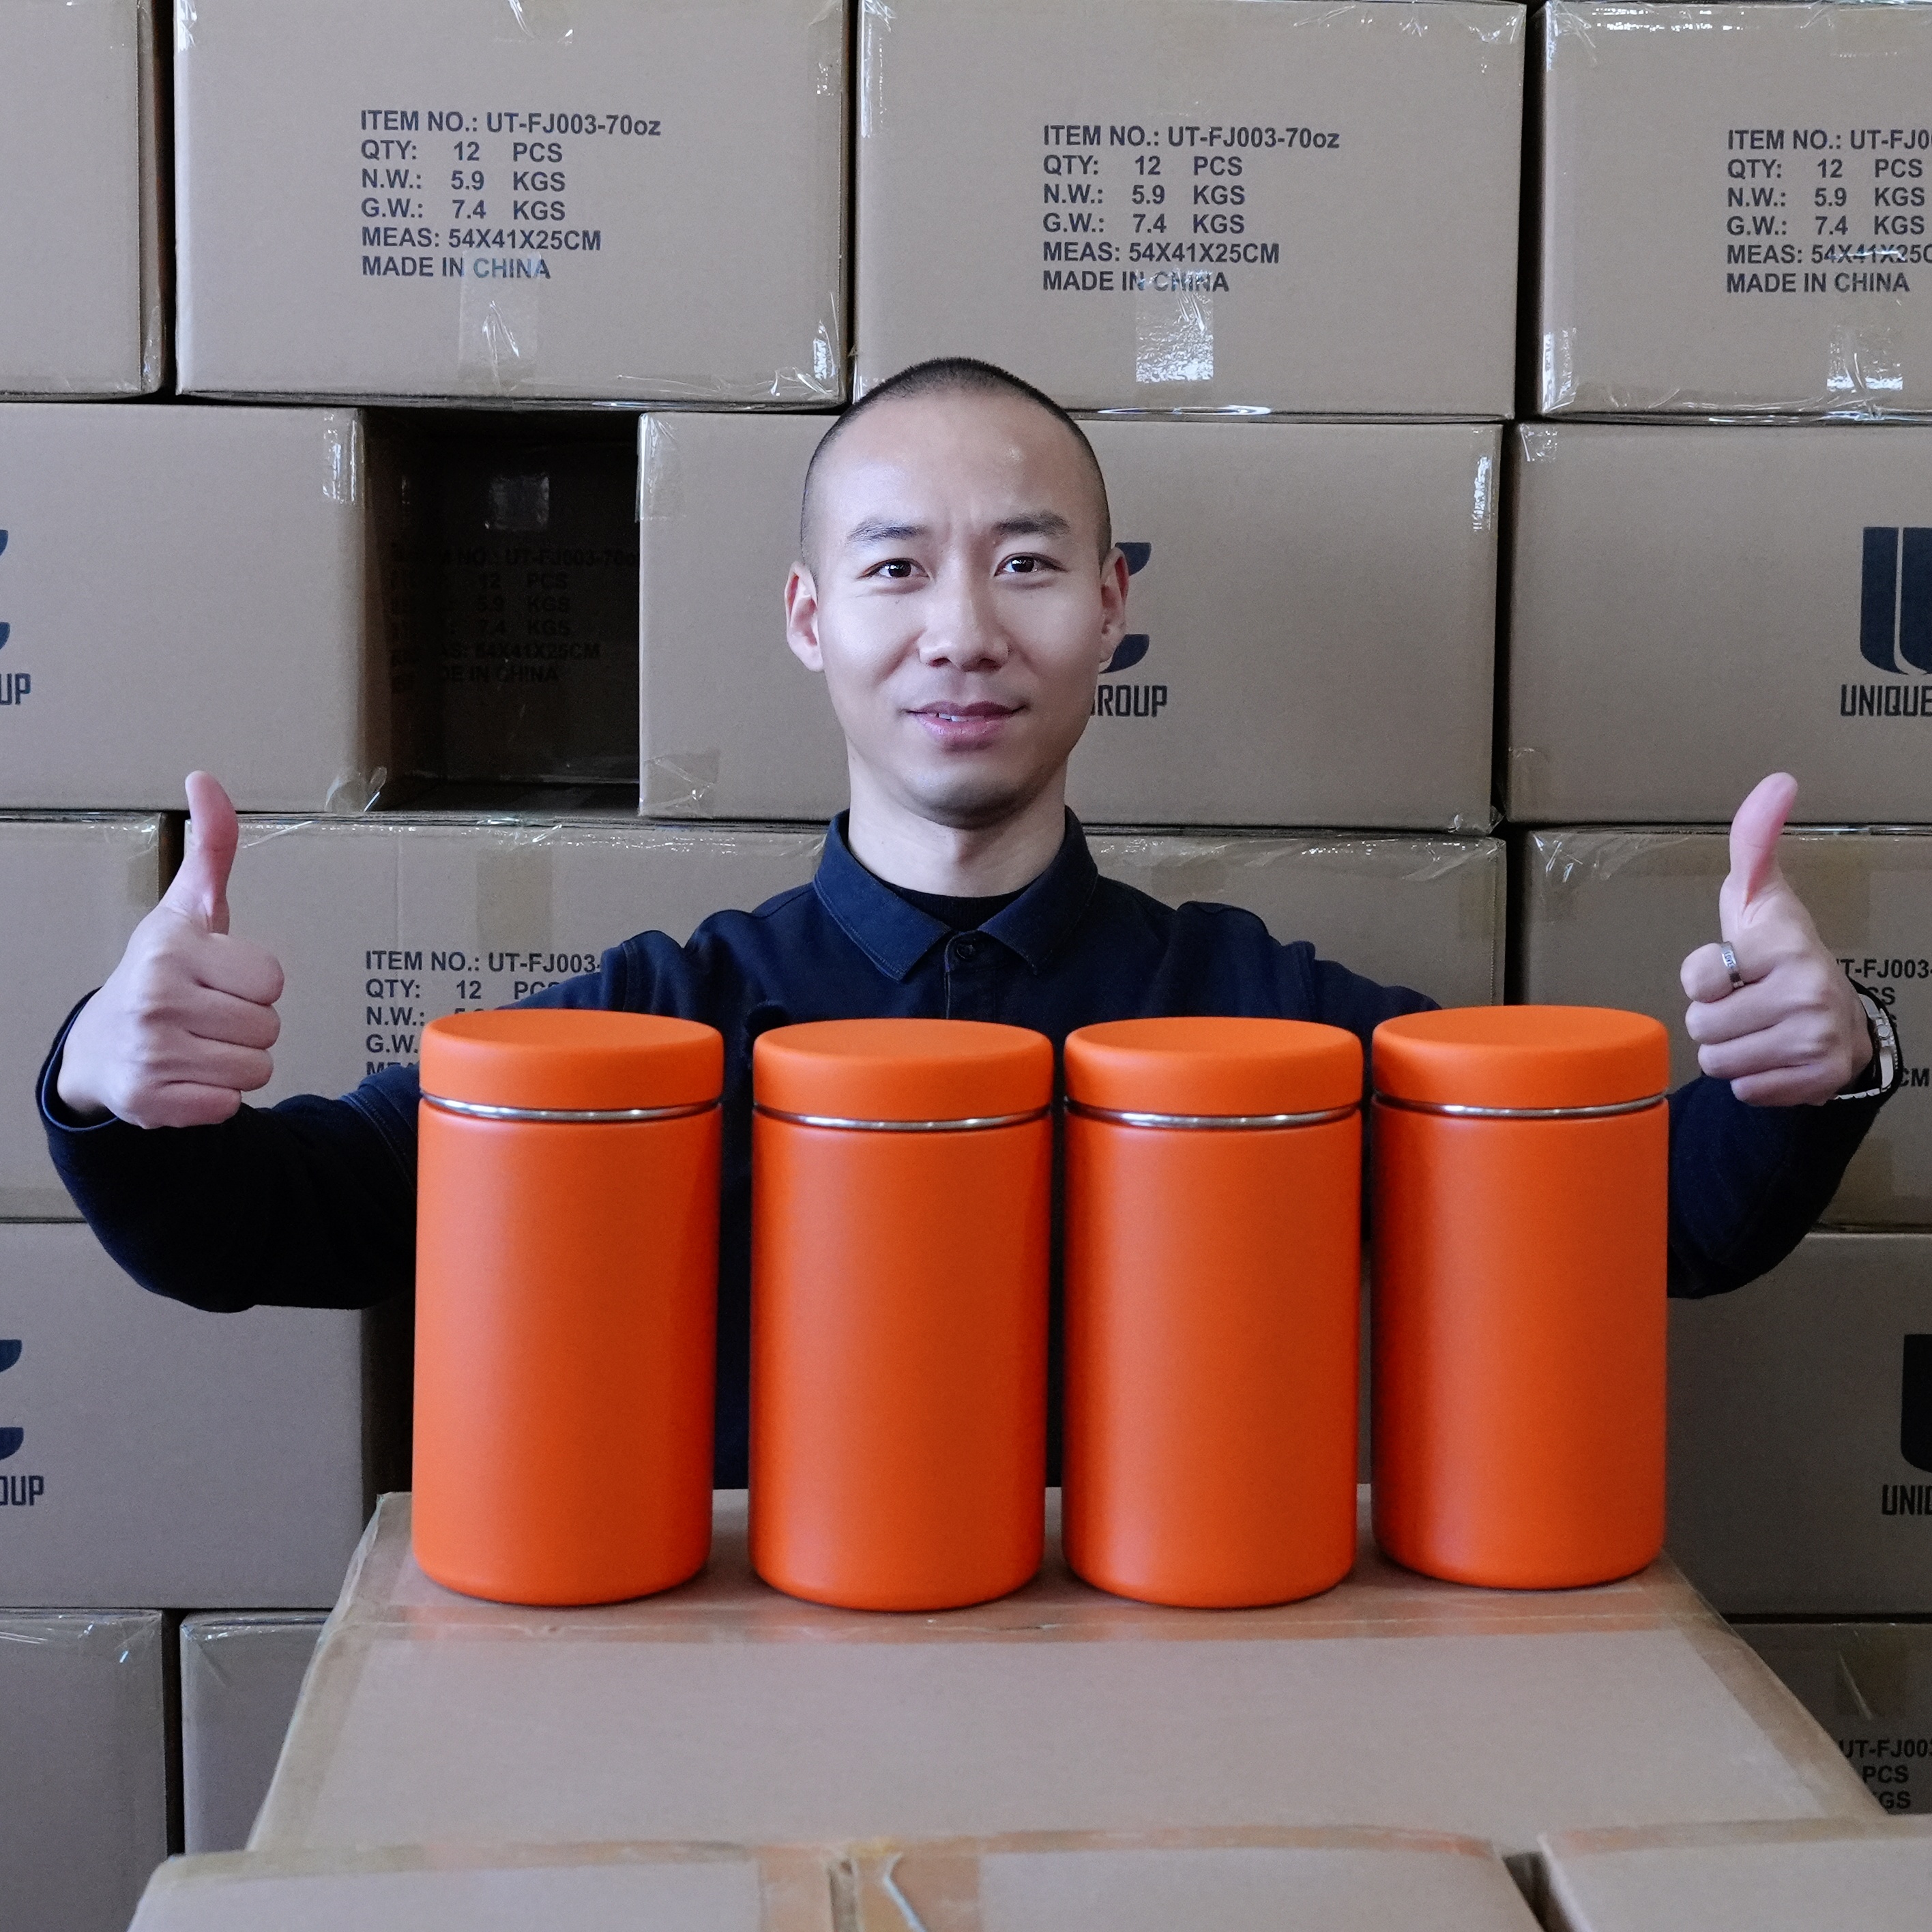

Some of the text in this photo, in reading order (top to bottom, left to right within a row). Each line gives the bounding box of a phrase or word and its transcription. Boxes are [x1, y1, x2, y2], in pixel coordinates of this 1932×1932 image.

[362, 110, 660, 136] ITEM NO.: UT-FJ003-70oz
[1044, 125, 1339, 148] ITEM NO.: UT-FJ003-70oz
[1729, 129, 1932, 149] ITEM NO.: UT-FJ0
[362, 139, 562, 162] QTY: 12 PCS
[1044, 155, 1242, 176] QTY: 12 PCS
[1728, 159, 1922, 179] QTY: 12 PCS
[362, 169, 565, 192] N.W.: 5.9 KGS
[1044, 184, 1244, 205] N.W.: 5.9 KGS
[1728, 187, 1924, 207] N.W.: 5.9 KGS
[362, 198, 565, 220] G.W.: 7.4 KGS
[1043, 213, 1244, 234] G.W.: 7.4 KGS
[1727, 216, 1924, 235] G.W.: 7.4 KGS
[362, 226, 600, 250] MEAS: 54X41X25CM
[1044, 241, 1279, 263] MEAS: 54X41X25CM
[1727, 244, 1802, 264] MEAS:
[363, 256, 551, 278] MADE IN CHINA
[1043, 270, 1229, 291] MADE IN CHINA
[1727, 273, 1909, 293] MADE IN CHINA
[1092, 684, 1167, 717] ROUP
[1841, 684, 1932, 716] UNIQUE
[366, 951, 422, 970] ITEM
[431, 952, 479, 971] NO.:
[1836, 958, 1932, 978] T-FJ003-
[366, 978, 561, 999] QTY: 12 PC
[367, 1006, 424, 1026] N.W.:
[1839, 1740, 1932, 1758] UT-FJ00
[1862, 1766, 1908, 1783] PCS
[1873, 1791, 1910, 1809] GS
